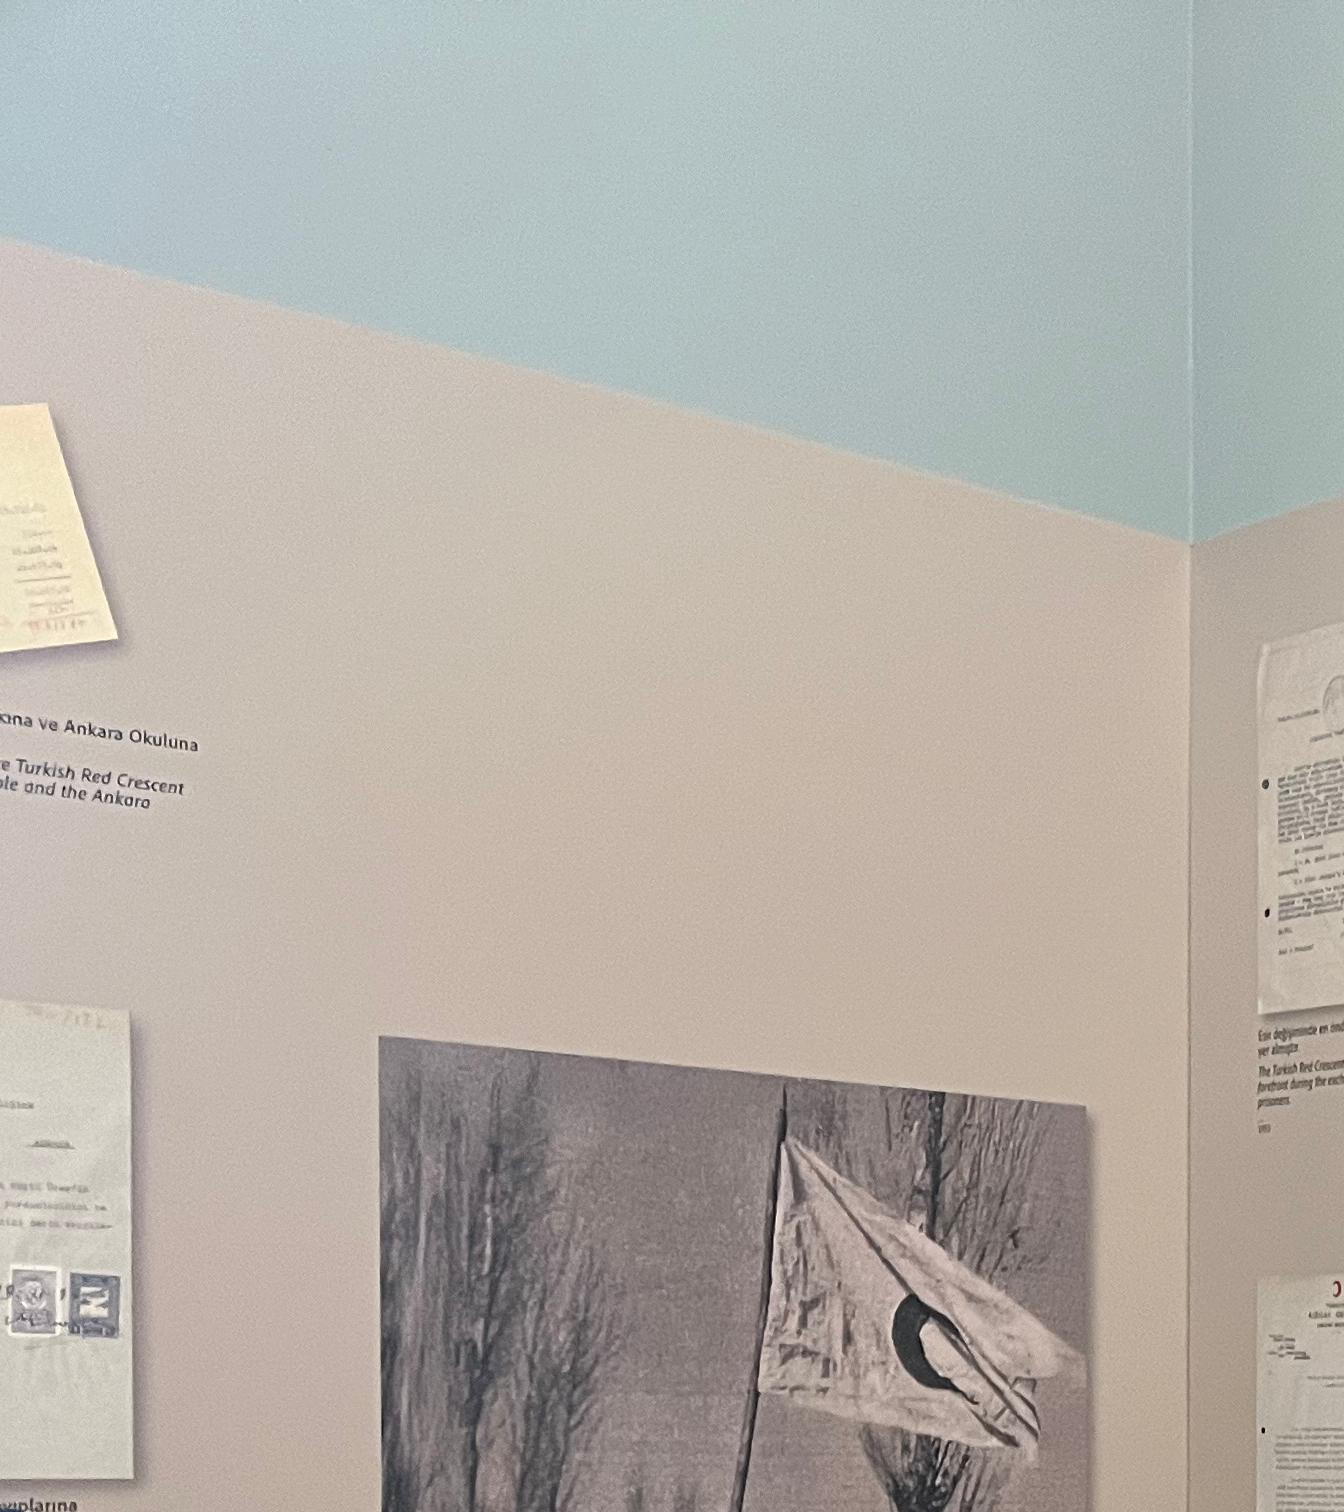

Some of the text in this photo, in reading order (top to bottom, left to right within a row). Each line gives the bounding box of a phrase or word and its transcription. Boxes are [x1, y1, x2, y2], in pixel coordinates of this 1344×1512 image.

[38, 718, 58, 732] ve
[64, 719, 123, 741] Ankara
[129, 729, 199, 752] Okuluna
[16, 758, 75, 780] Turkish
[81, 768, 111, 785] Red
[117, 773, 185, 796] Crescent
[24, 782, 56, 796] and
[61, 785, 87, 801] the
[92, 790, 151, 809] Ankara
